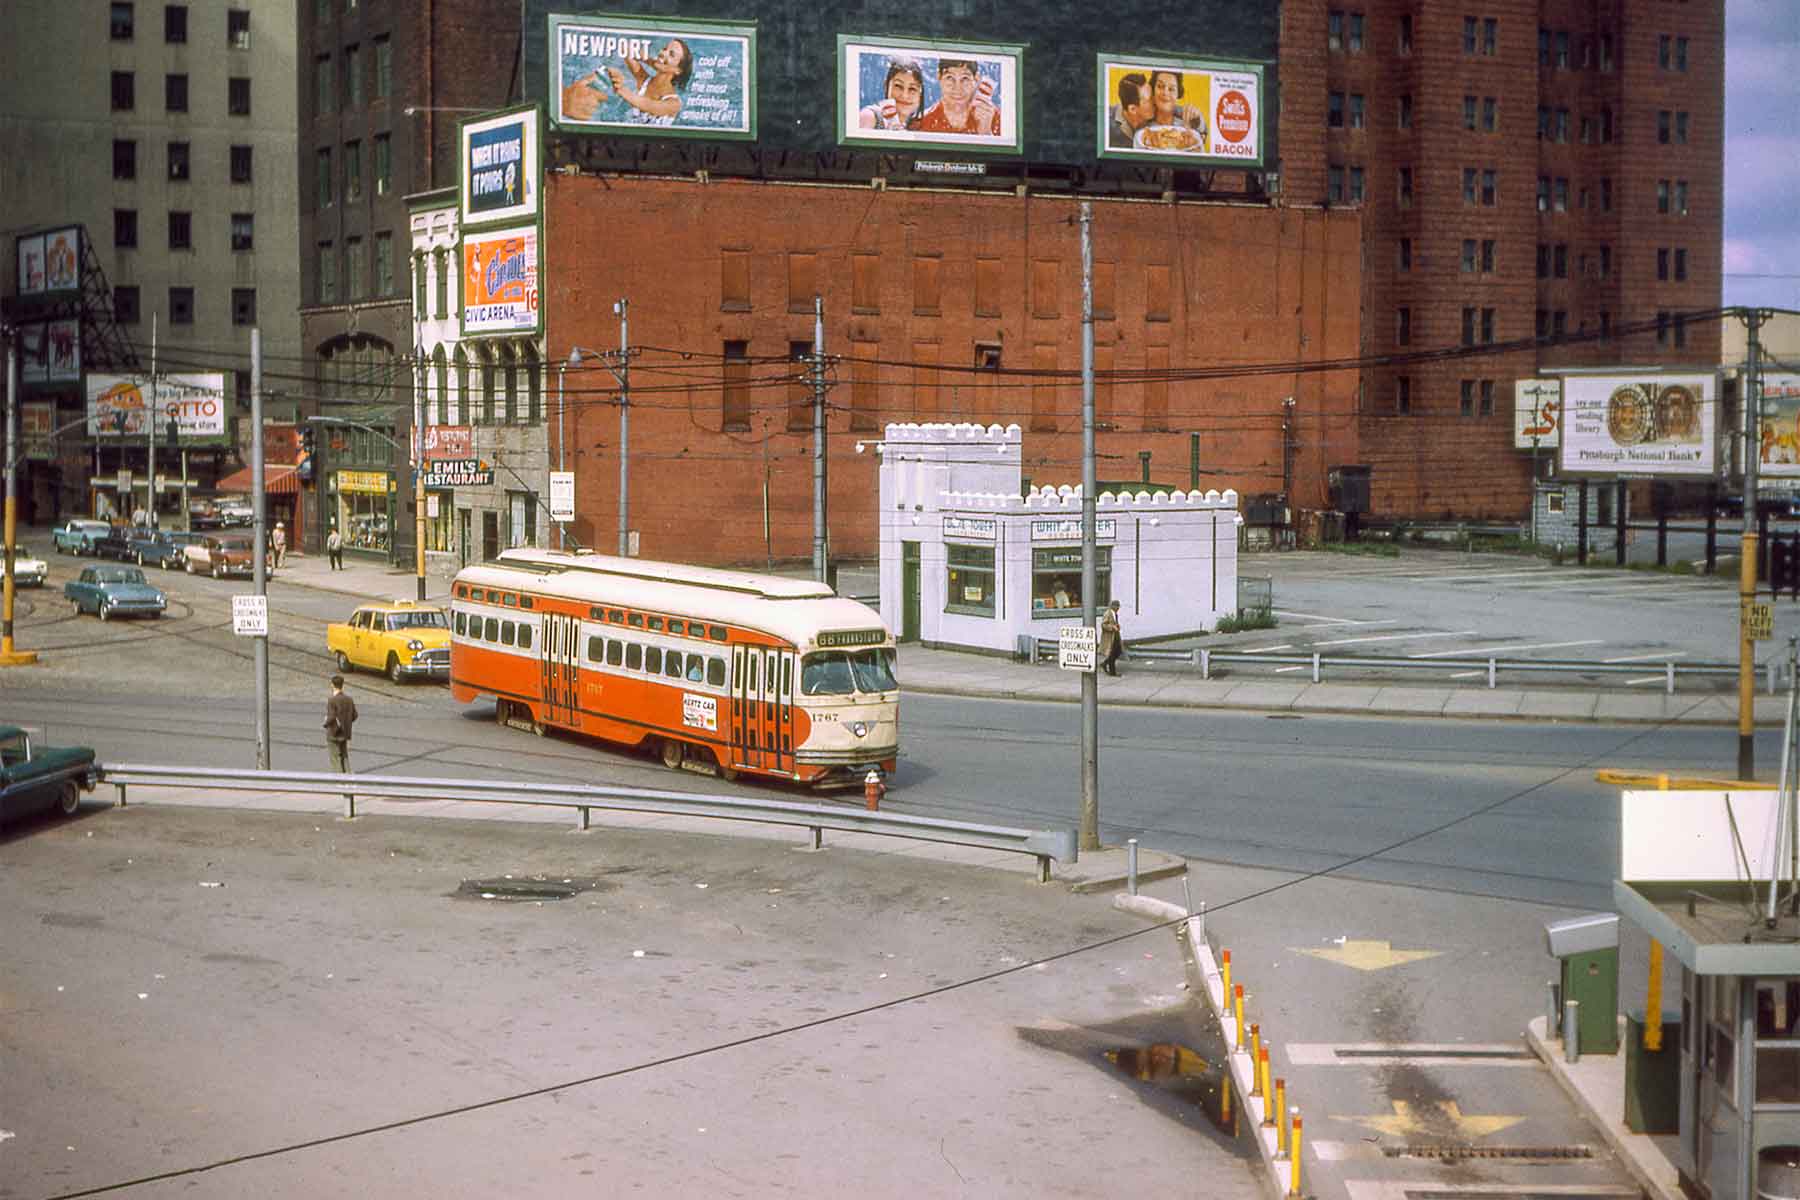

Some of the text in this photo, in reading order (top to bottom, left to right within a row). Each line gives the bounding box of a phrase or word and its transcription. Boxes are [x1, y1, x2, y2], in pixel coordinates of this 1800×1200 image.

[564, 33, 652, 61] NEWPORT
[1215, 144, 1253, 155] BACON
[487, 304, 516, 321] ARENA
[166, 401, 217, 417] OTTO
[1579, 449, 1693, 463] Pittsburgh National Bank
[433, 461, 477, 475] EMIL'S
[1075, 520, 1112, 531] TER
[1751, 606, 1768, 616] NO
[240, 619, 261, 628] ONLY
[1060, 627, 1095, 640] CROSS AT
[1060, 640, 1095, 652] CROSSWALKS
[1066, 652, 1089, 664] ONLY
[703, 701, 715, 710] CAR
[812, 713, 839, 722] 1767
